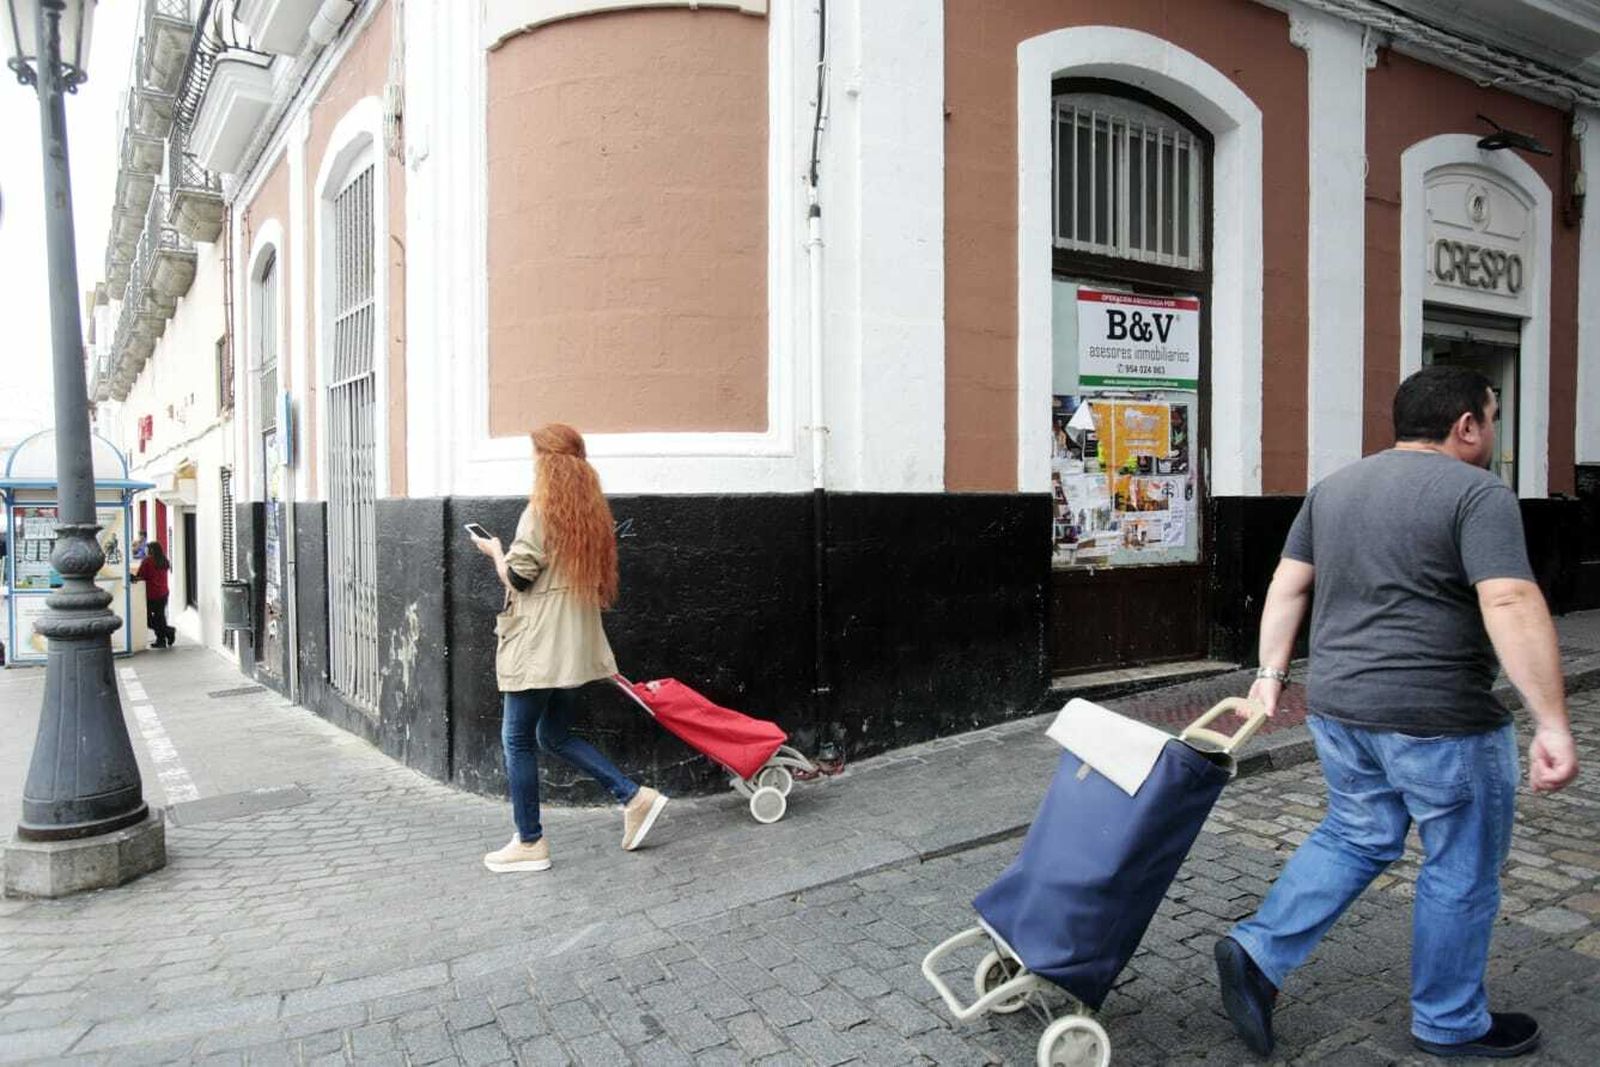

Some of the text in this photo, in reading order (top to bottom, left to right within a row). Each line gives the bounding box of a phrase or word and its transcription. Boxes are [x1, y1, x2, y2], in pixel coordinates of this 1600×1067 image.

[1434, 238, 1523, 294] CRESPO
[1106, 309, 1174, 344] B&V
[1089, 345, 1190, 363] asesores inmobiliarios
